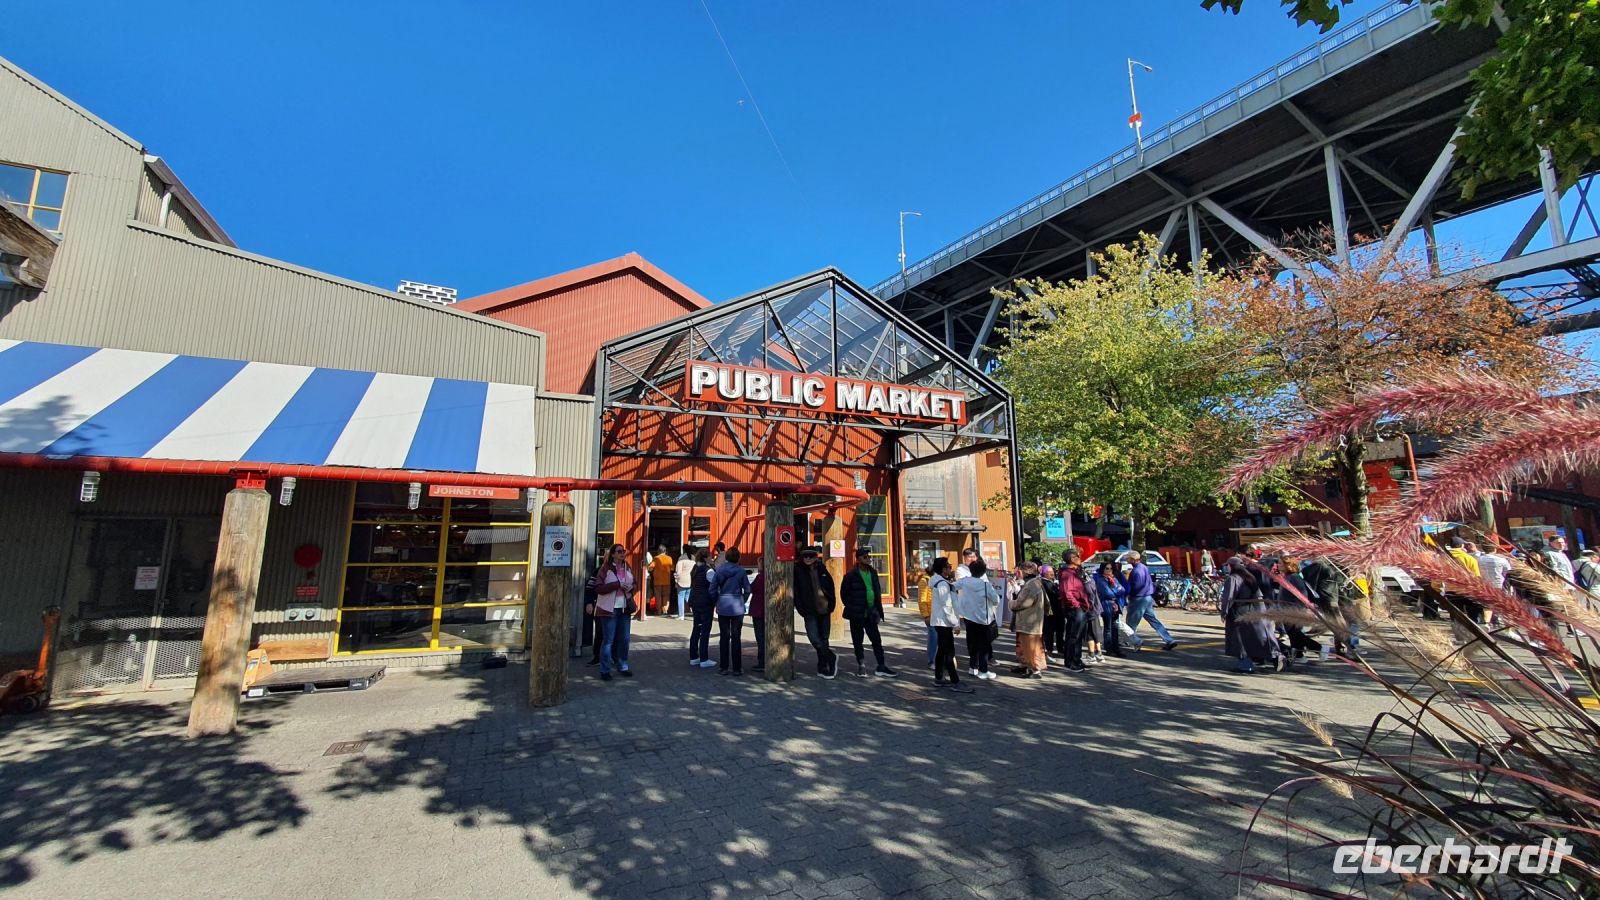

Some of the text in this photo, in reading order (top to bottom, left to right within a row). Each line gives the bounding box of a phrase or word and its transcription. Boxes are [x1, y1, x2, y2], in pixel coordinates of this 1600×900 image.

[690, 364, 964, 420] PUBLIC MARKET
[433, 486, 494, 497] JOHNSTON
